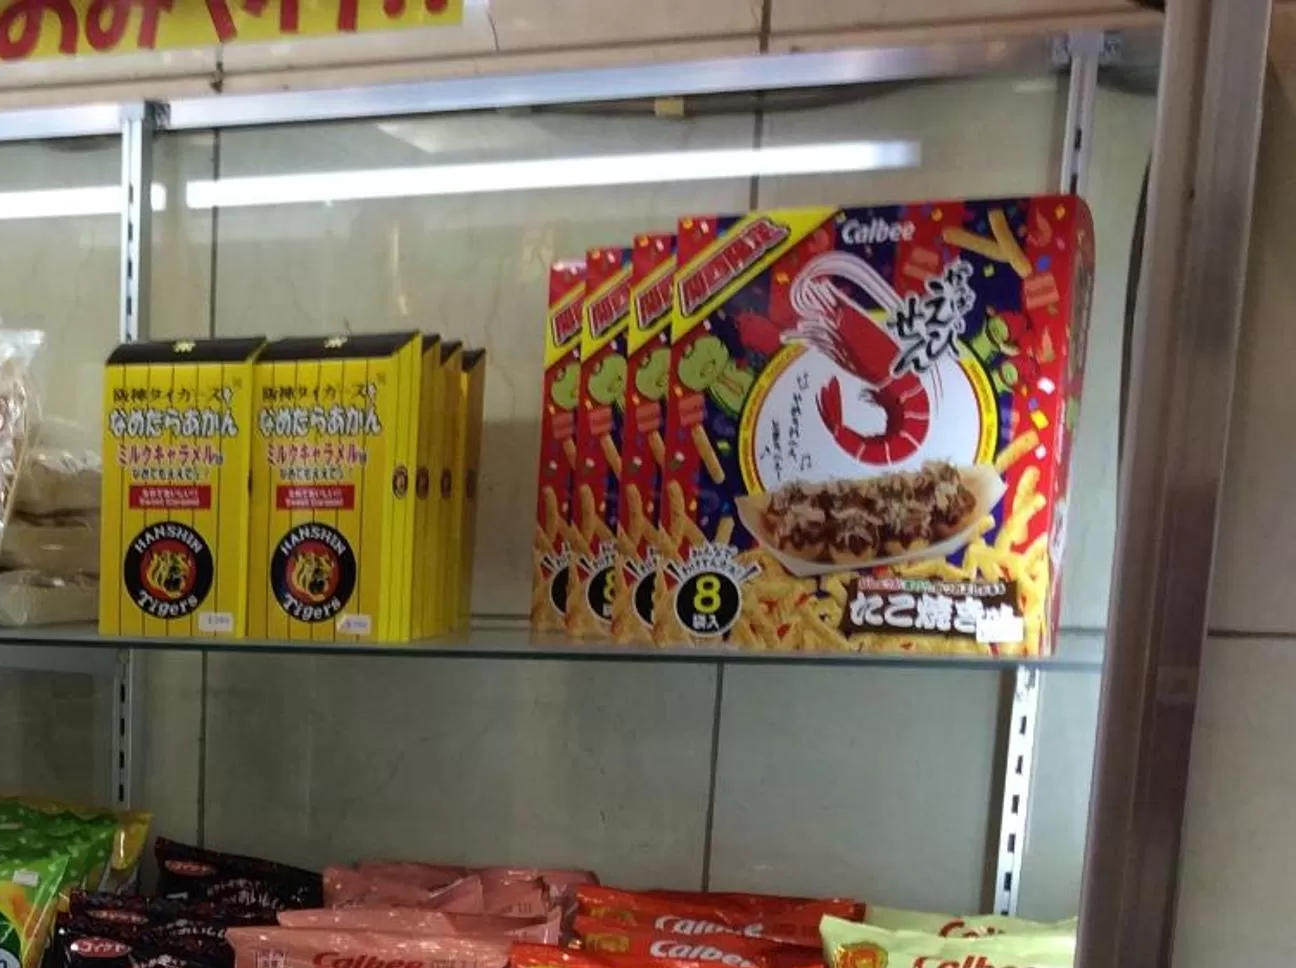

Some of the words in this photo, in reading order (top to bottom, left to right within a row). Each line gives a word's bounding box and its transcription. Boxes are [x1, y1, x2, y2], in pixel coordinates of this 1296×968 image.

[841, 218, 915, 245] Calbee
[134, 525, 203, 554] HANSHIN
[280, 527, 346, 556] HANSHIN
[137, 590, 198, 616] Tigers
[282, 594, 341, 621] Tigers
[693, 575, 721, 614] 8
